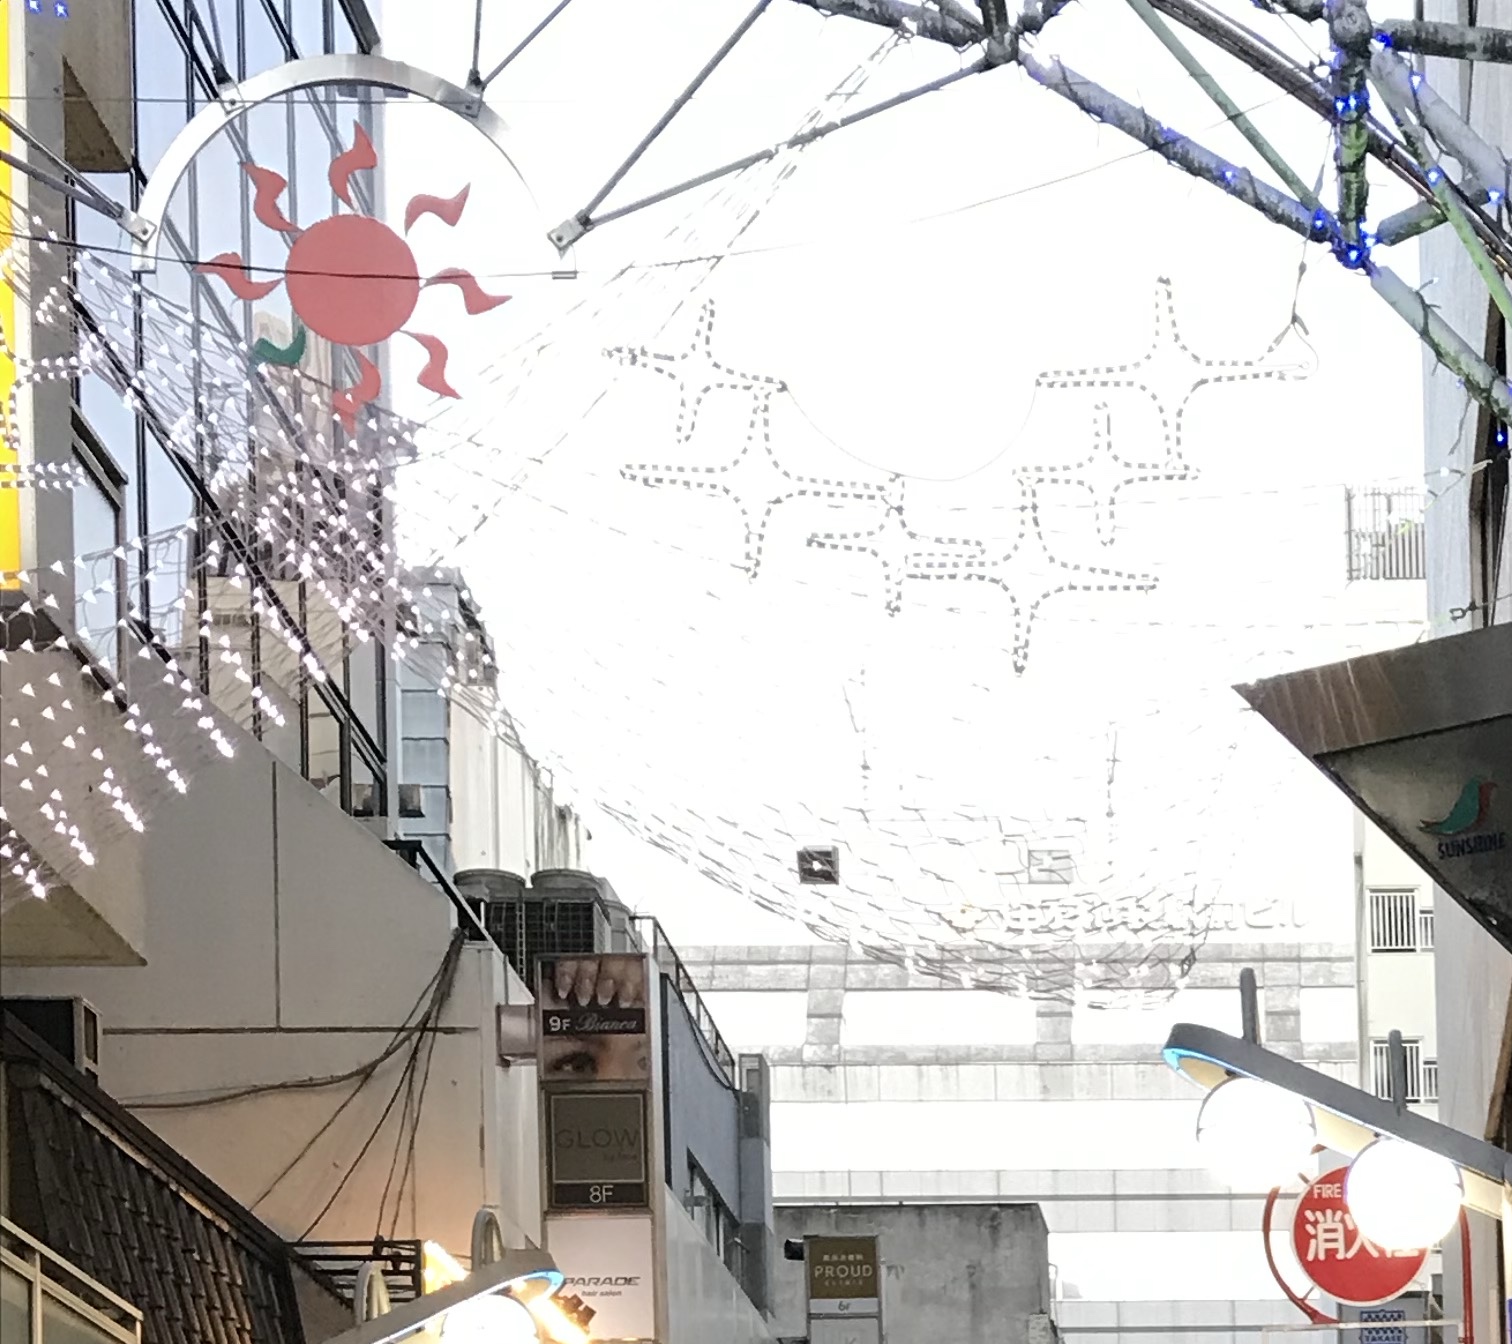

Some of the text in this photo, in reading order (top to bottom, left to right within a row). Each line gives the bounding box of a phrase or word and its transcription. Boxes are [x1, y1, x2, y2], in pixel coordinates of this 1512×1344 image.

[548, 1016, 571, 1032] 9F
[555, 1127, 640, 1150] GLOW
[589, 1185, 614, 1204] 8F
[1313, 1183, 1342, 1199] FIRE
[814, 1264, 873, 1278] PROUD
[564, 1274, 641, 1288] PARADE
[1364, 1334, 1402, 1343] TAKASE
